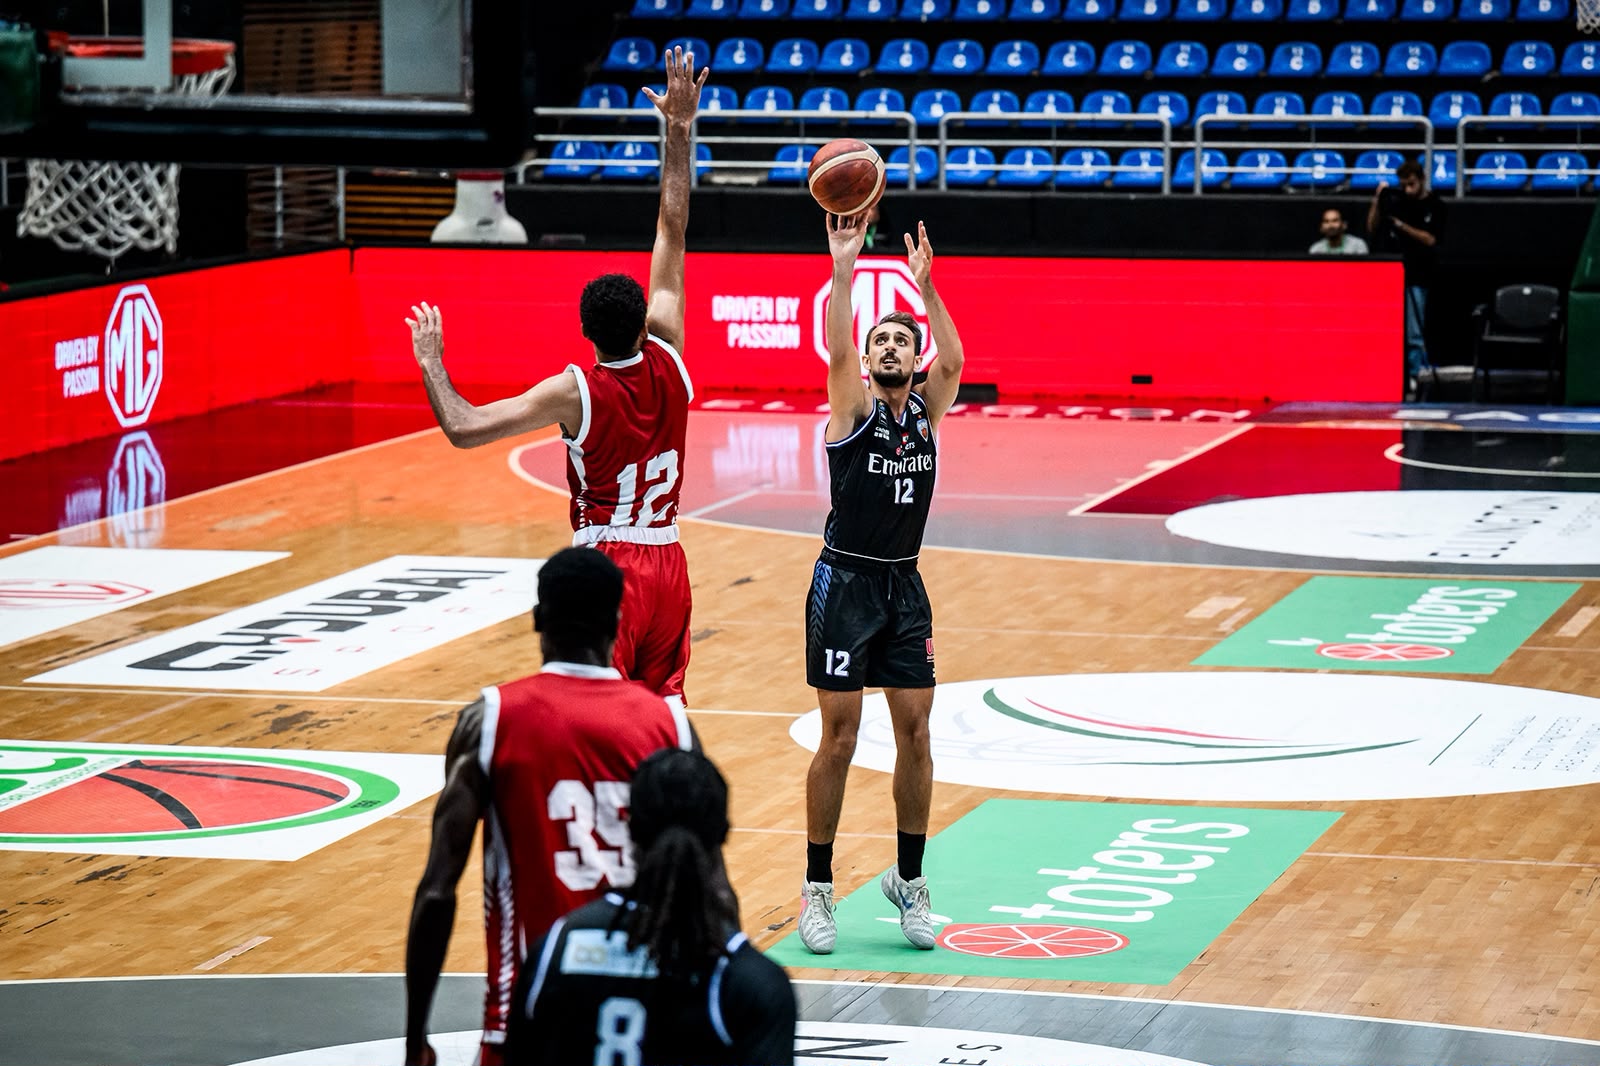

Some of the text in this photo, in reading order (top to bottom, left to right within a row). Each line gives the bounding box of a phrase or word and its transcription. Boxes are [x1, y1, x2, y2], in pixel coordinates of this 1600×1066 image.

[712, 296, 800, 322] DRIVEN BY
[55, 336, 99, 370] DRIVEN BY
[727, 324, 800, 349] PASSION
[110, 298, 159, 415] MG
[63, 366, 99, 398] PASSION
[868, 453, 932, 476] Emirates
[610, 448, 679, 528] 12
[894, 478, 914, 504] 12
[1345, 585, 1518, 644] toters
[825, 648, 851, 677] 12
[547, 779, 637, 892] 35
[988, 818, 1250, 923] toters
[594, 996, 647, 1066] 8
